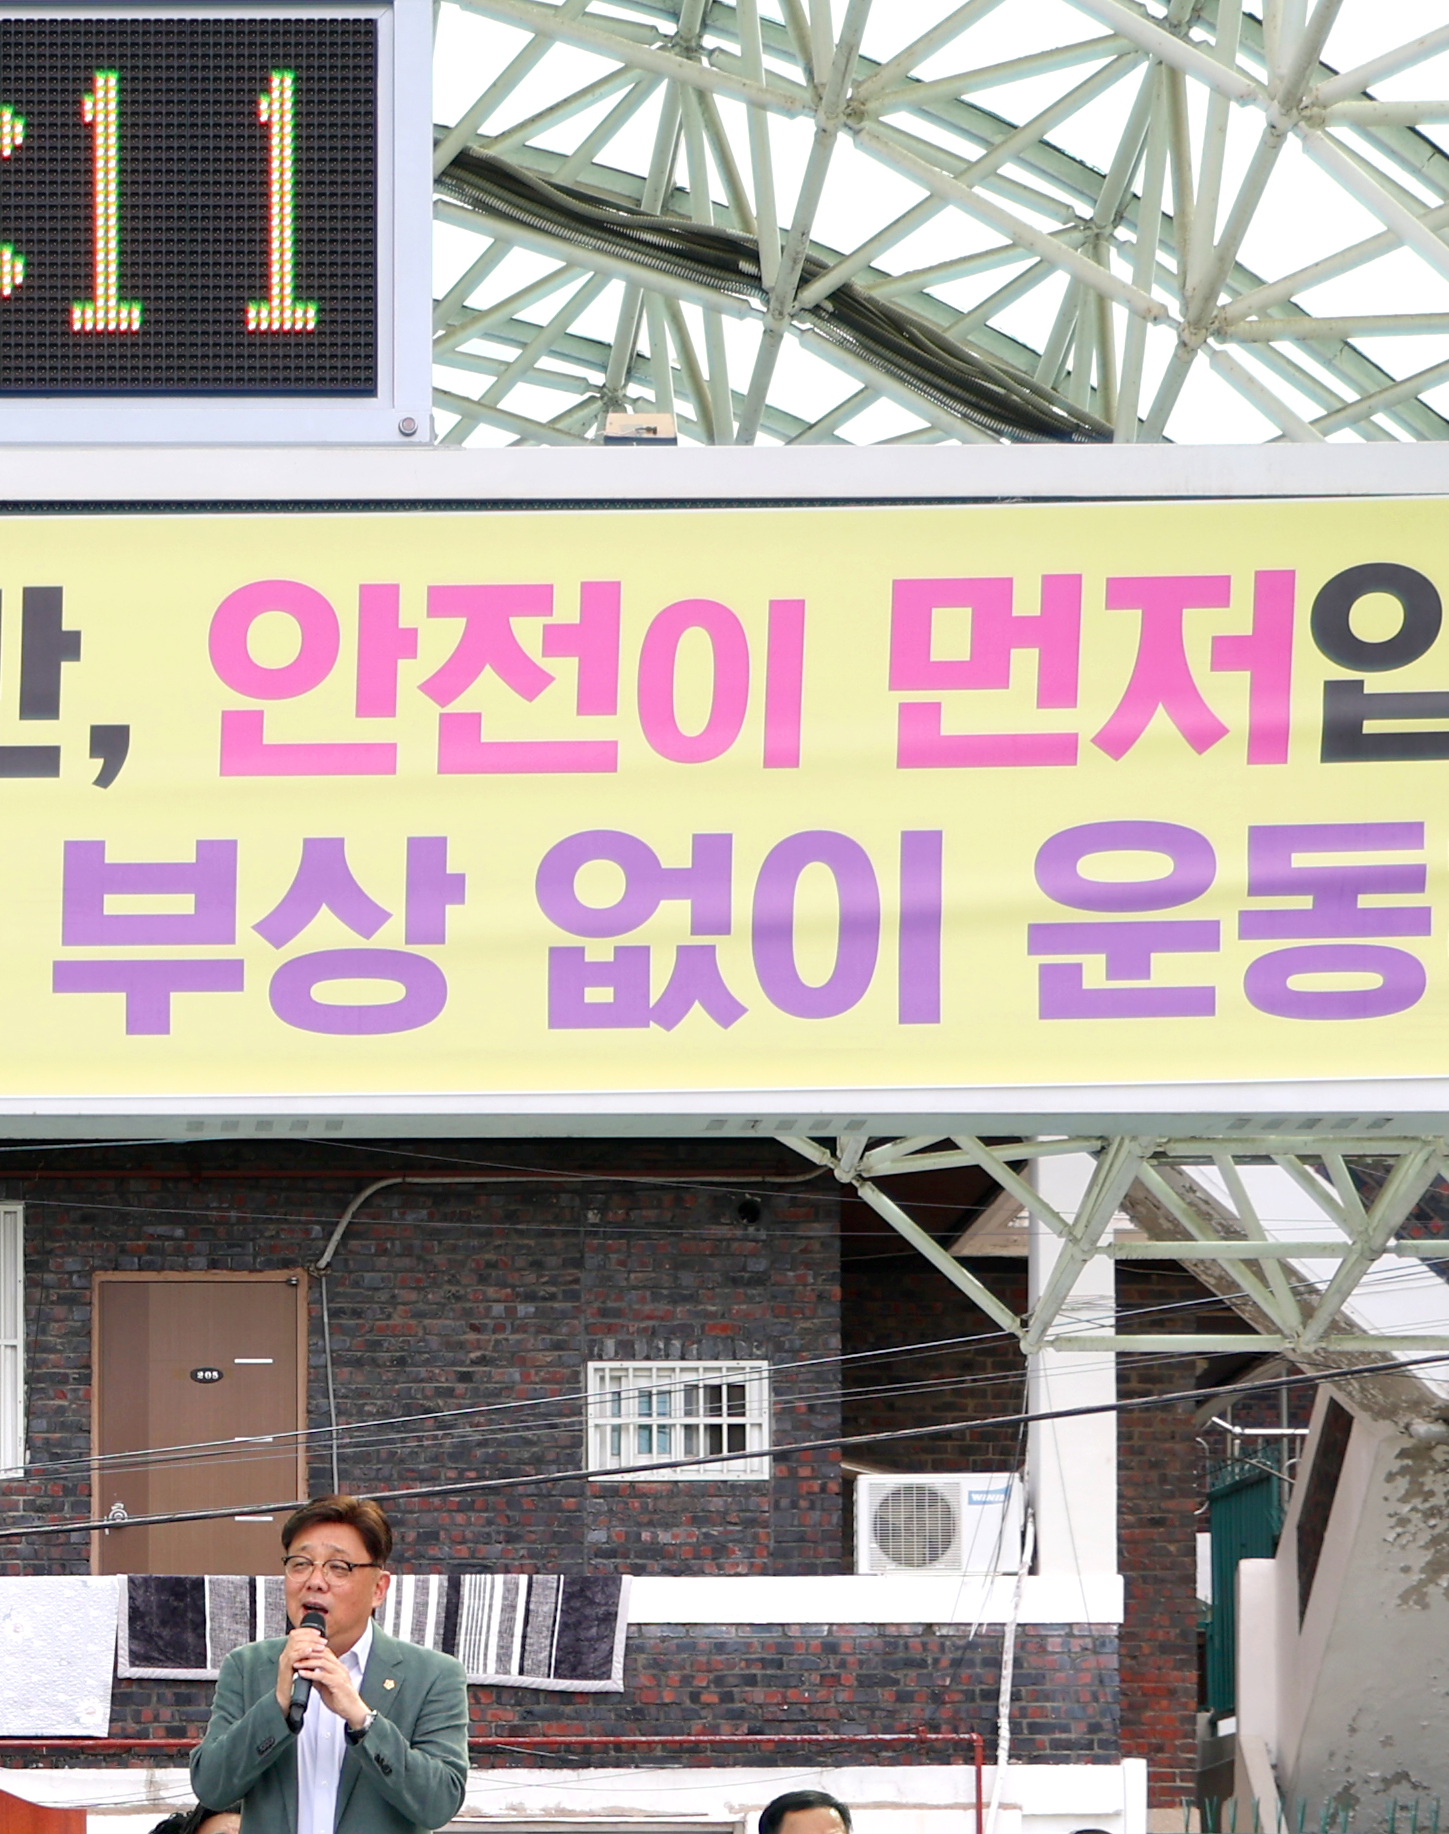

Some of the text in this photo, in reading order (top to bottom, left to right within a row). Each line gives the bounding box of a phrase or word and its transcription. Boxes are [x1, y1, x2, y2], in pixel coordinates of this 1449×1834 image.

[208, 580, 805, 776] 안전이
[53, 836, 467, 1035] 부상
[535, 830, 943, 1031] 없이
